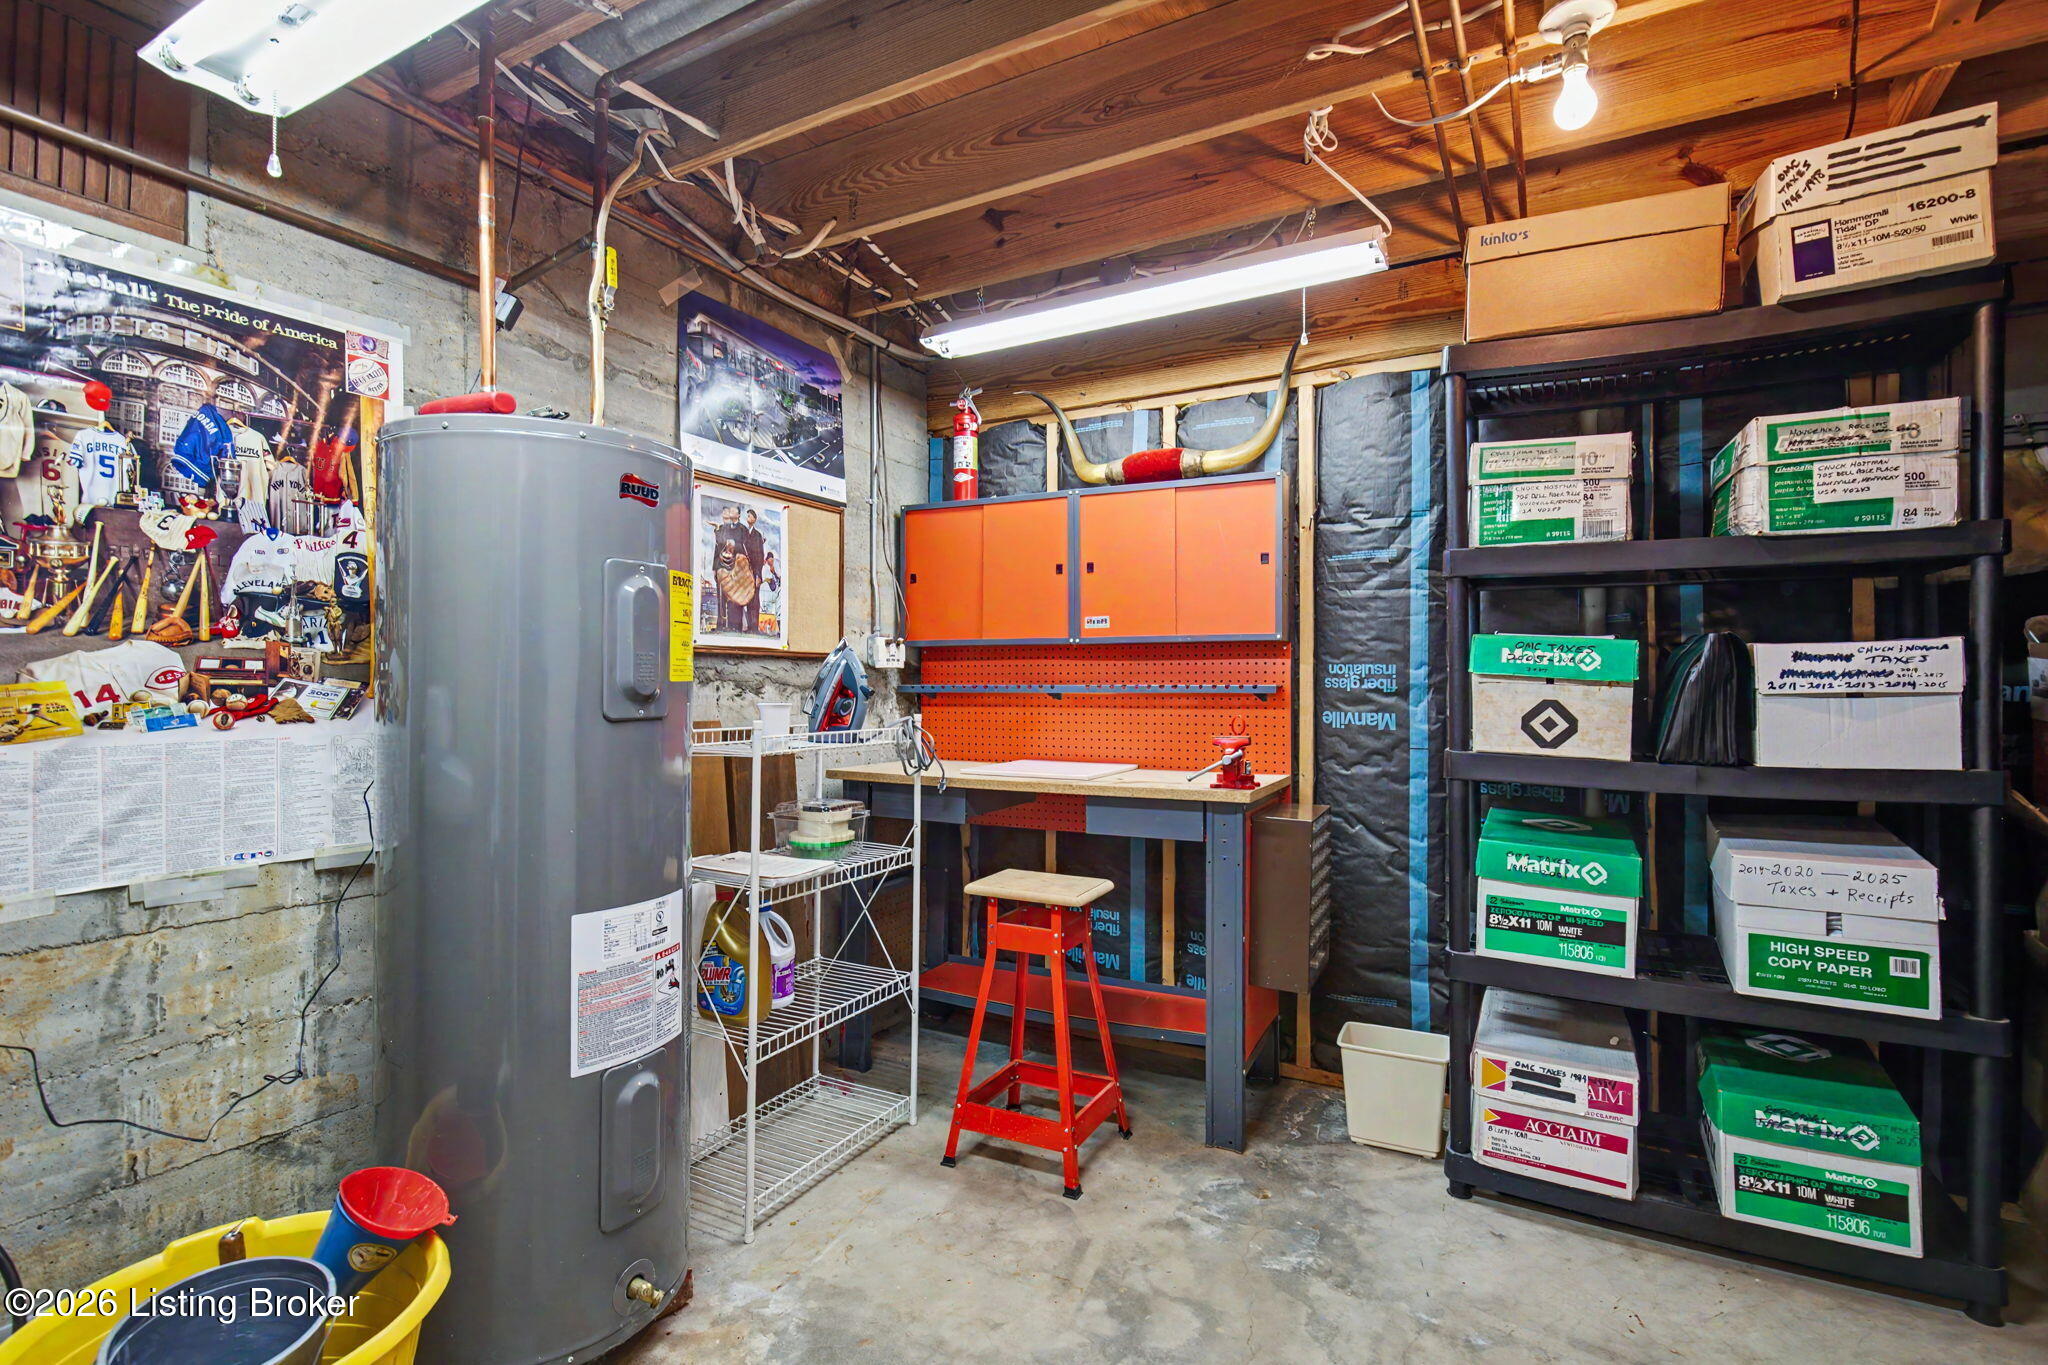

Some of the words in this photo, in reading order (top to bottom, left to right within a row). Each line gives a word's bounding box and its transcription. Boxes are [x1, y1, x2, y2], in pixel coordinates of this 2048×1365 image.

[1907, 188, 1977, 213] 16200-8
[1864, 218, 1880, 229] DP
[1949, 213, 1979, 226] White
[1480, 230, 1529, 248] kinko's
[164, 292, 200, 314] The
[203, 303, 250, 327] Pride
[253, 318, 270, 332] of
[272, 323, 338, 350] America
[42, 458, 61, 481] 6
[98, 454, 115, 479] 5
[1817, 462, 1847, 472] CHUCK
[1904, 472, 1926, 481] 500
[620, 482, 659, 500] RUUD
[1583, 493, 1594, 501] 84
[1903, 508, 1918, 517] 84
[342, 531, 358, 550] 4
[1501, 647, 1575, 666] Matrix
[1515, 641, 1542, 651] OMC
[1547, 643, 1596, 654] TAXES
[1865, 655, 1930, 665] TAXES
[1328, 663, 1397, 678] insulation
[73, 683, 121, 708] 14
[1322, 710, 1397, 731] Manville
[1506, 852, 1581, 879] Matrix
[1852, 869, 1908, 886] 2025
[1767, 881, 1817, 898] Taxes
[1847, 887, 1915, 910] Receipts
[1560, 905, 1591, 916] Matrix
[1535, 919, 1553, 932] 10M
[1558, 925, 1583, 937] WHITE
[1559, 943, 1594, 961] 115806
[1770, 940, 1810, 956] HIGH
[1814, 946, 1870, 962] SPEED
[1767, 956, 1813, 971] COPY
[1817, 961, 1873, 978] PAPER
[1514, 1060, 1535, 1072] OMC
[1539, 1066, 1567, 1078] TAXES
[1524, 1118, 1601, 1147] ACCLAIM
[1825, 1171, 1864, 1186] Matrix
[1796, 1185, 1817, 1200] 10M
[1824, 1193, 1856, 1208] WHITE
[1825, 1213, 1871, 1236] 115806
